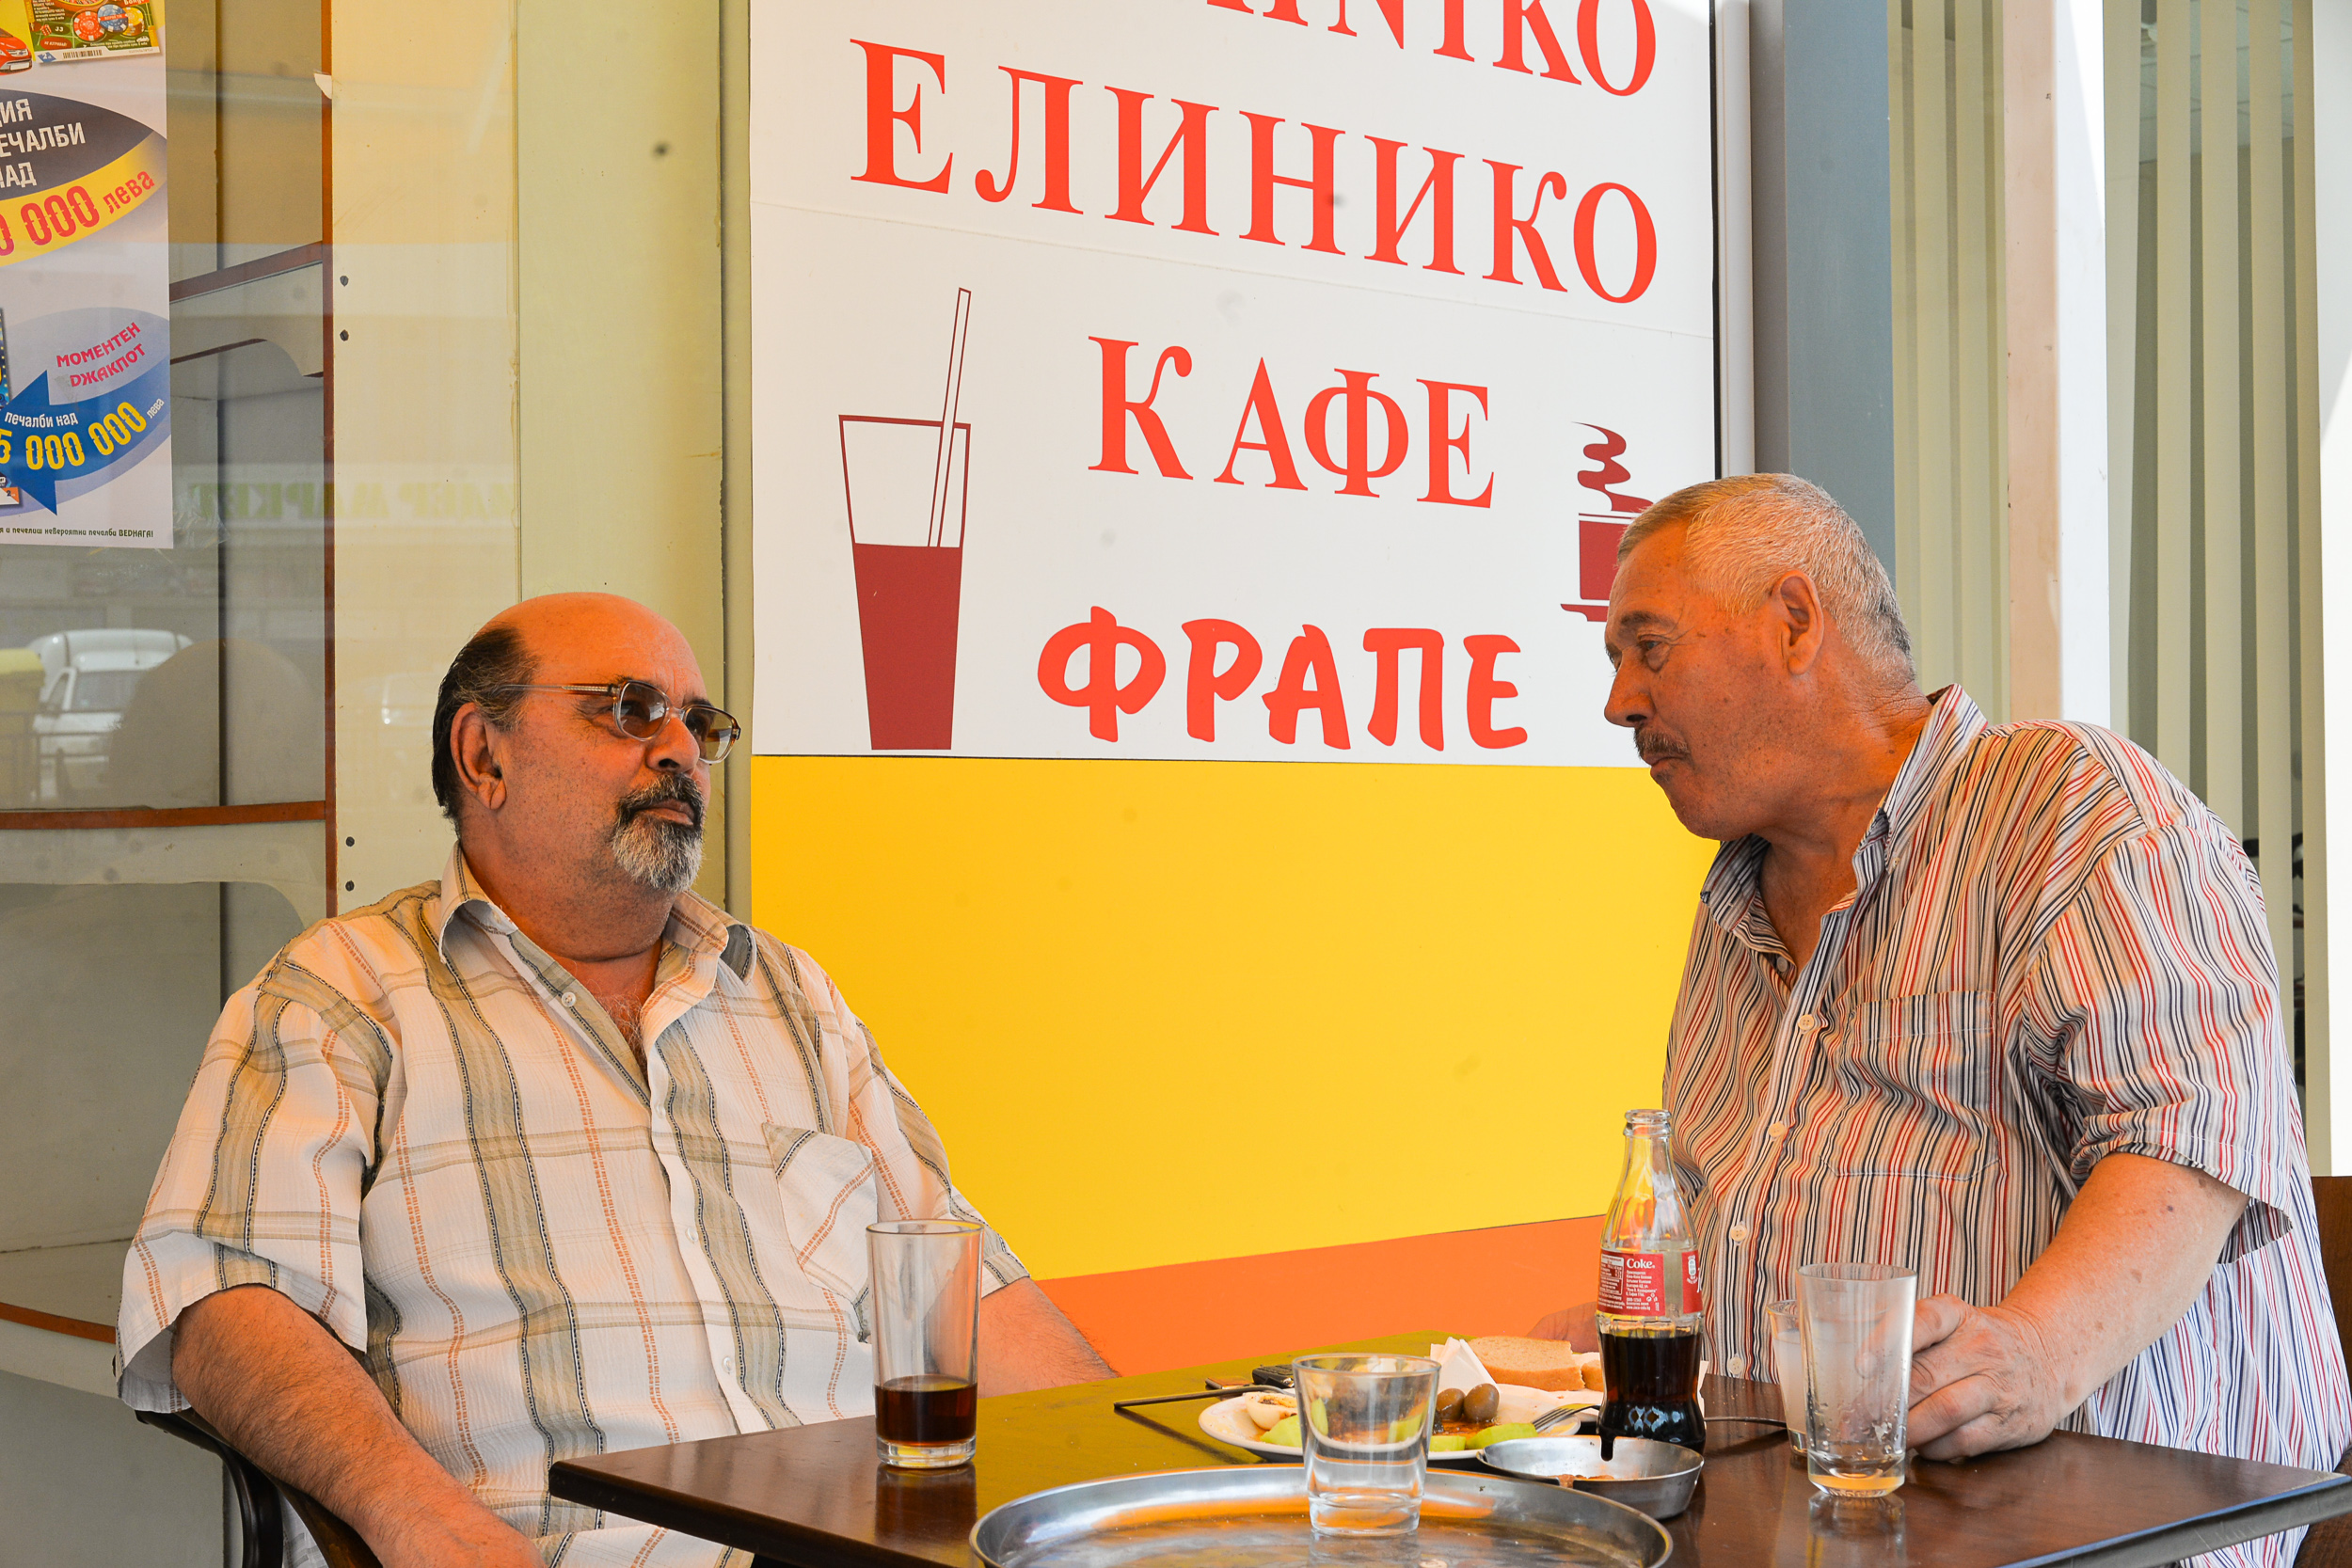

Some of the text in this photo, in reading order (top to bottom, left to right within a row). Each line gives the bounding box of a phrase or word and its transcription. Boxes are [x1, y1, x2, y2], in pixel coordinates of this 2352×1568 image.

[0, 98, 33, 128] ИЯ
[850, 39, 1658, 304] ЕЛИНИКО
[21, 185, 100, 246] 000
[103, 170, 155, 214] лева
[56, 322, 141, 368] МОМЕНТЕН
[4, 411, 79, 429] печалби над
[25, 431, 86, 470] 000
[87, 402, 147, 456] 000
[147, 398, 165, 420] лева
[1089, 337, 1495, 509] КАФЕ
[44, 527, 87, 537] невероятни
[88, 528, 117, 537] печалби
[1038, 606, 1528, 752] ФРАПЕ
